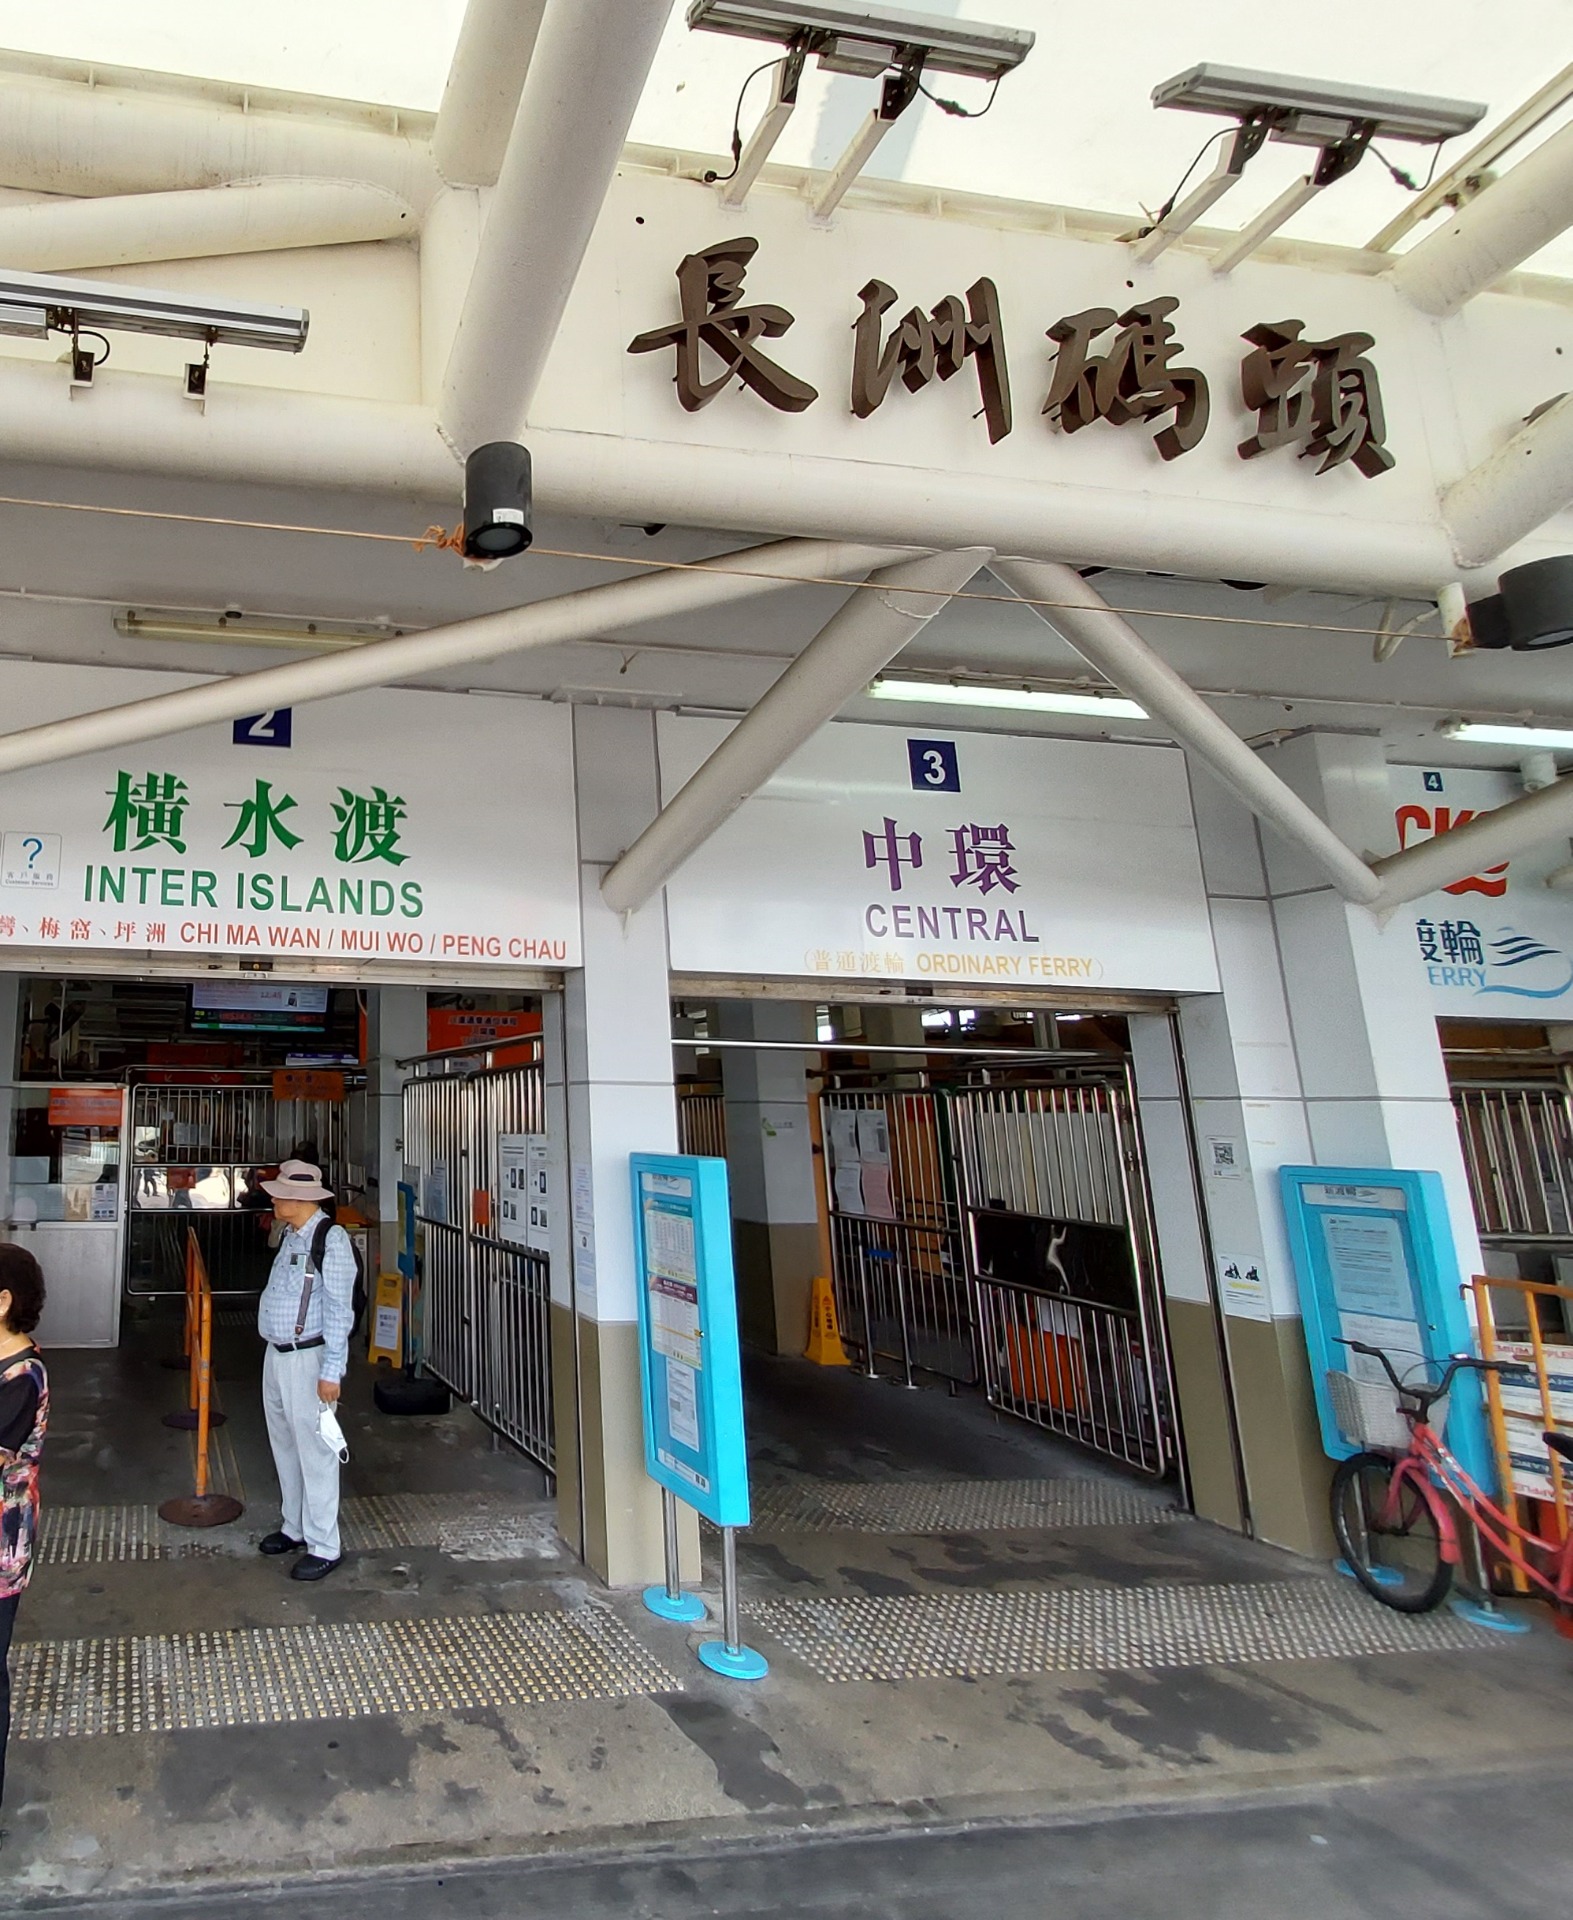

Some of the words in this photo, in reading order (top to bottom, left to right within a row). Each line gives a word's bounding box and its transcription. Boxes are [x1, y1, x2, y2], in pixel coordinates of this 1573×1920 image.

[627, 236, 1396, 479] 長洲碼頭
[248, 710, 275, 738] 2
[923, 749, 946, 785] 3
[1427, 774, 1439, 790] 4
[102, 769, 411, 867] 橫水渡
[1395, 804, 1488, 851] CK
[862, 816, 1022, 895] 中環
[84, 863, 219, 909] INTER
[236, 872, 424, 919] ISLANDS
[180, 921, 219, 944] CHI
[226, 924, 261, 946] MA
[267, 926, 321, 948] WAN
[340, 931, 380, 952] MUI
[386, 932, 424, 954] WO
[442, 935, 501, 957] PENG
[508, 937, 567, 960] CHAU
[865, 903, 1040, 943] CENTRAL
[917, 953, 1021, 976] ORDINARY
